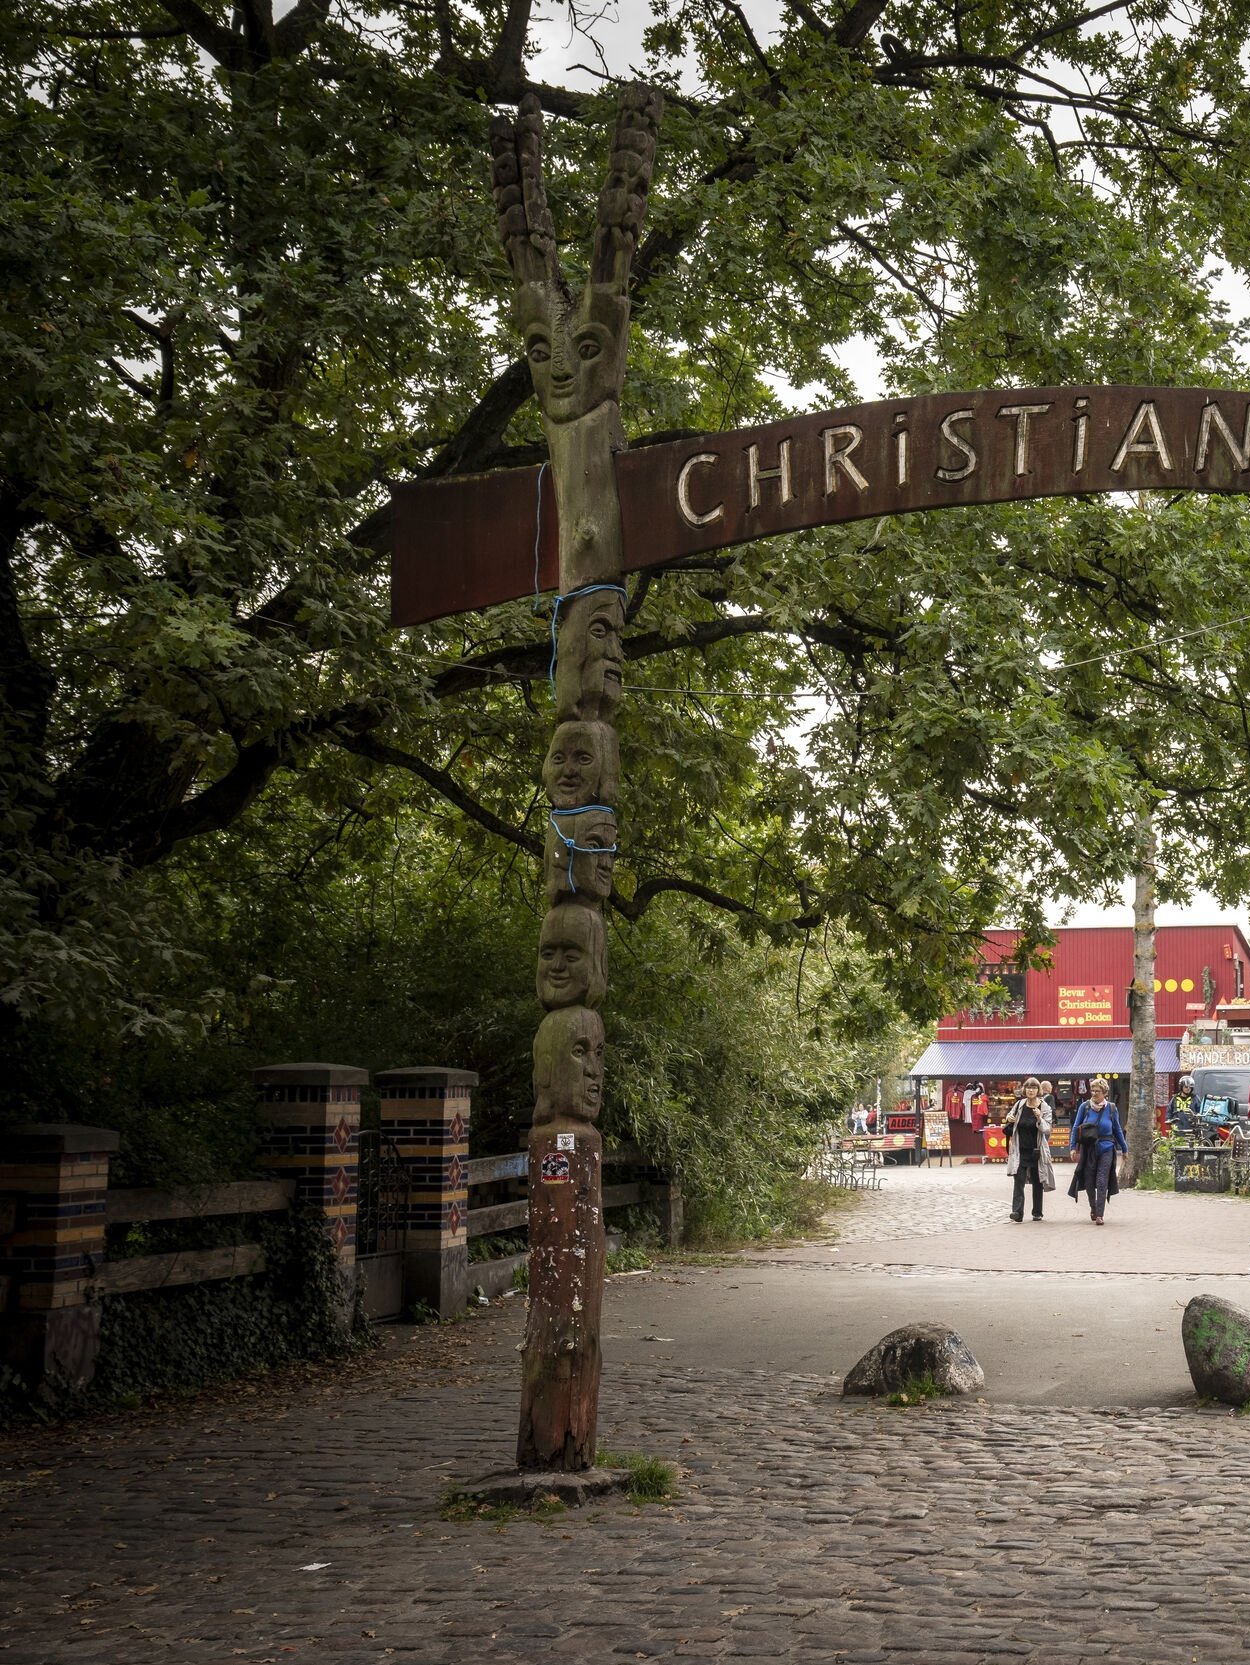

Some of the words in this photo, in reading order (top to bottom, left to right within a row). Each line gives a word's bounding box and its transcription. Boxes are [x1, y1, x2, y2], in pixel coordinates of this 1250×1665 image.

[1059, 988, 1086, 997] Bevar
[1059, 1000, 1111, 1009] Christiania
[1085, 1012, 1112, 1022] Boden
